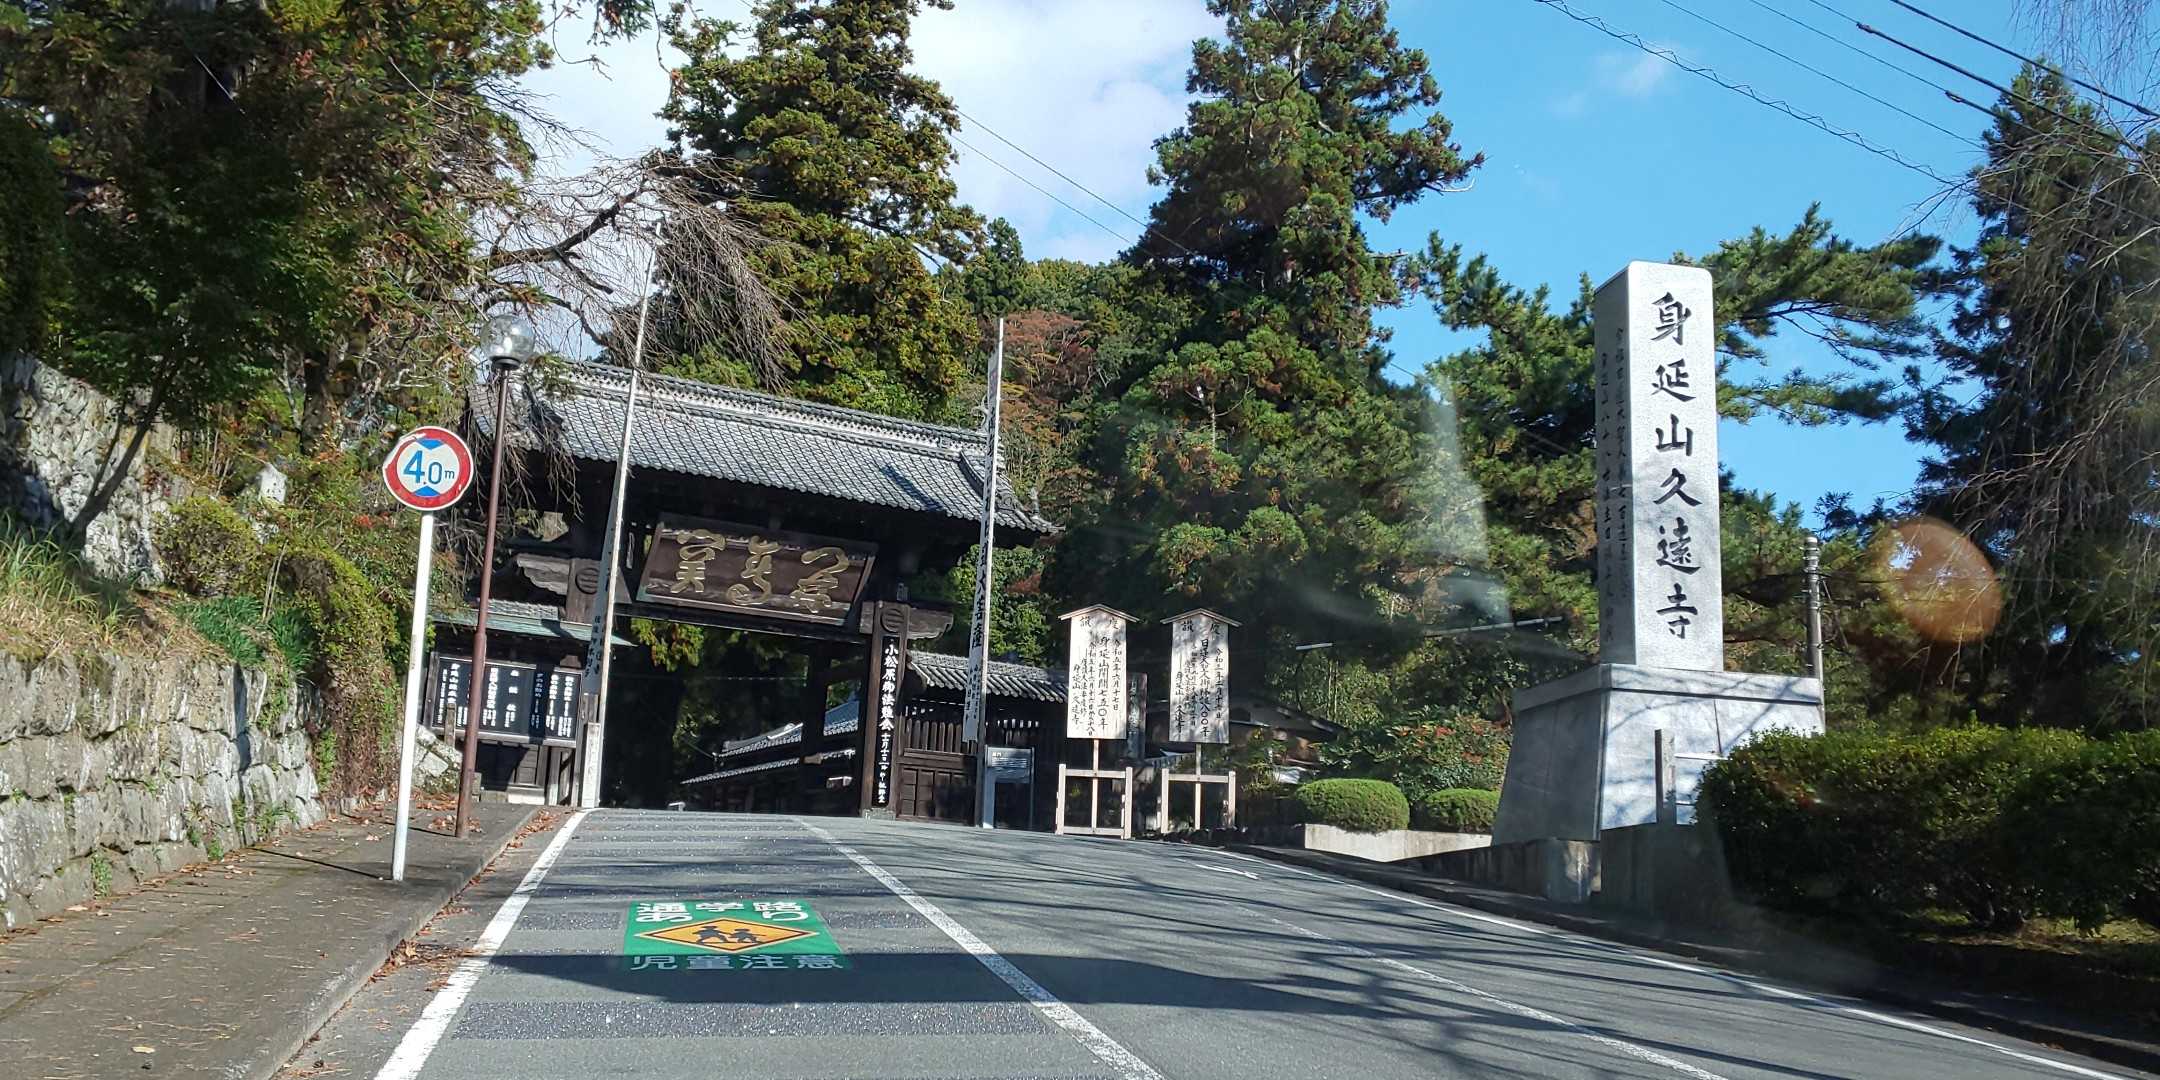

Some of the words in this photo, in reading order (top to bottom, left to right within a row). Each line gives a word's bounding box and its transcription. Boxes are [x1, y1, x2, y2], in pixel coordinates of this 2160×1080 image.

[1650, 291, 1702, 640] 身延山久遠寺
[637, 902, 803, 912] 通学路
[630, 955, 844, 971] 児童注意
